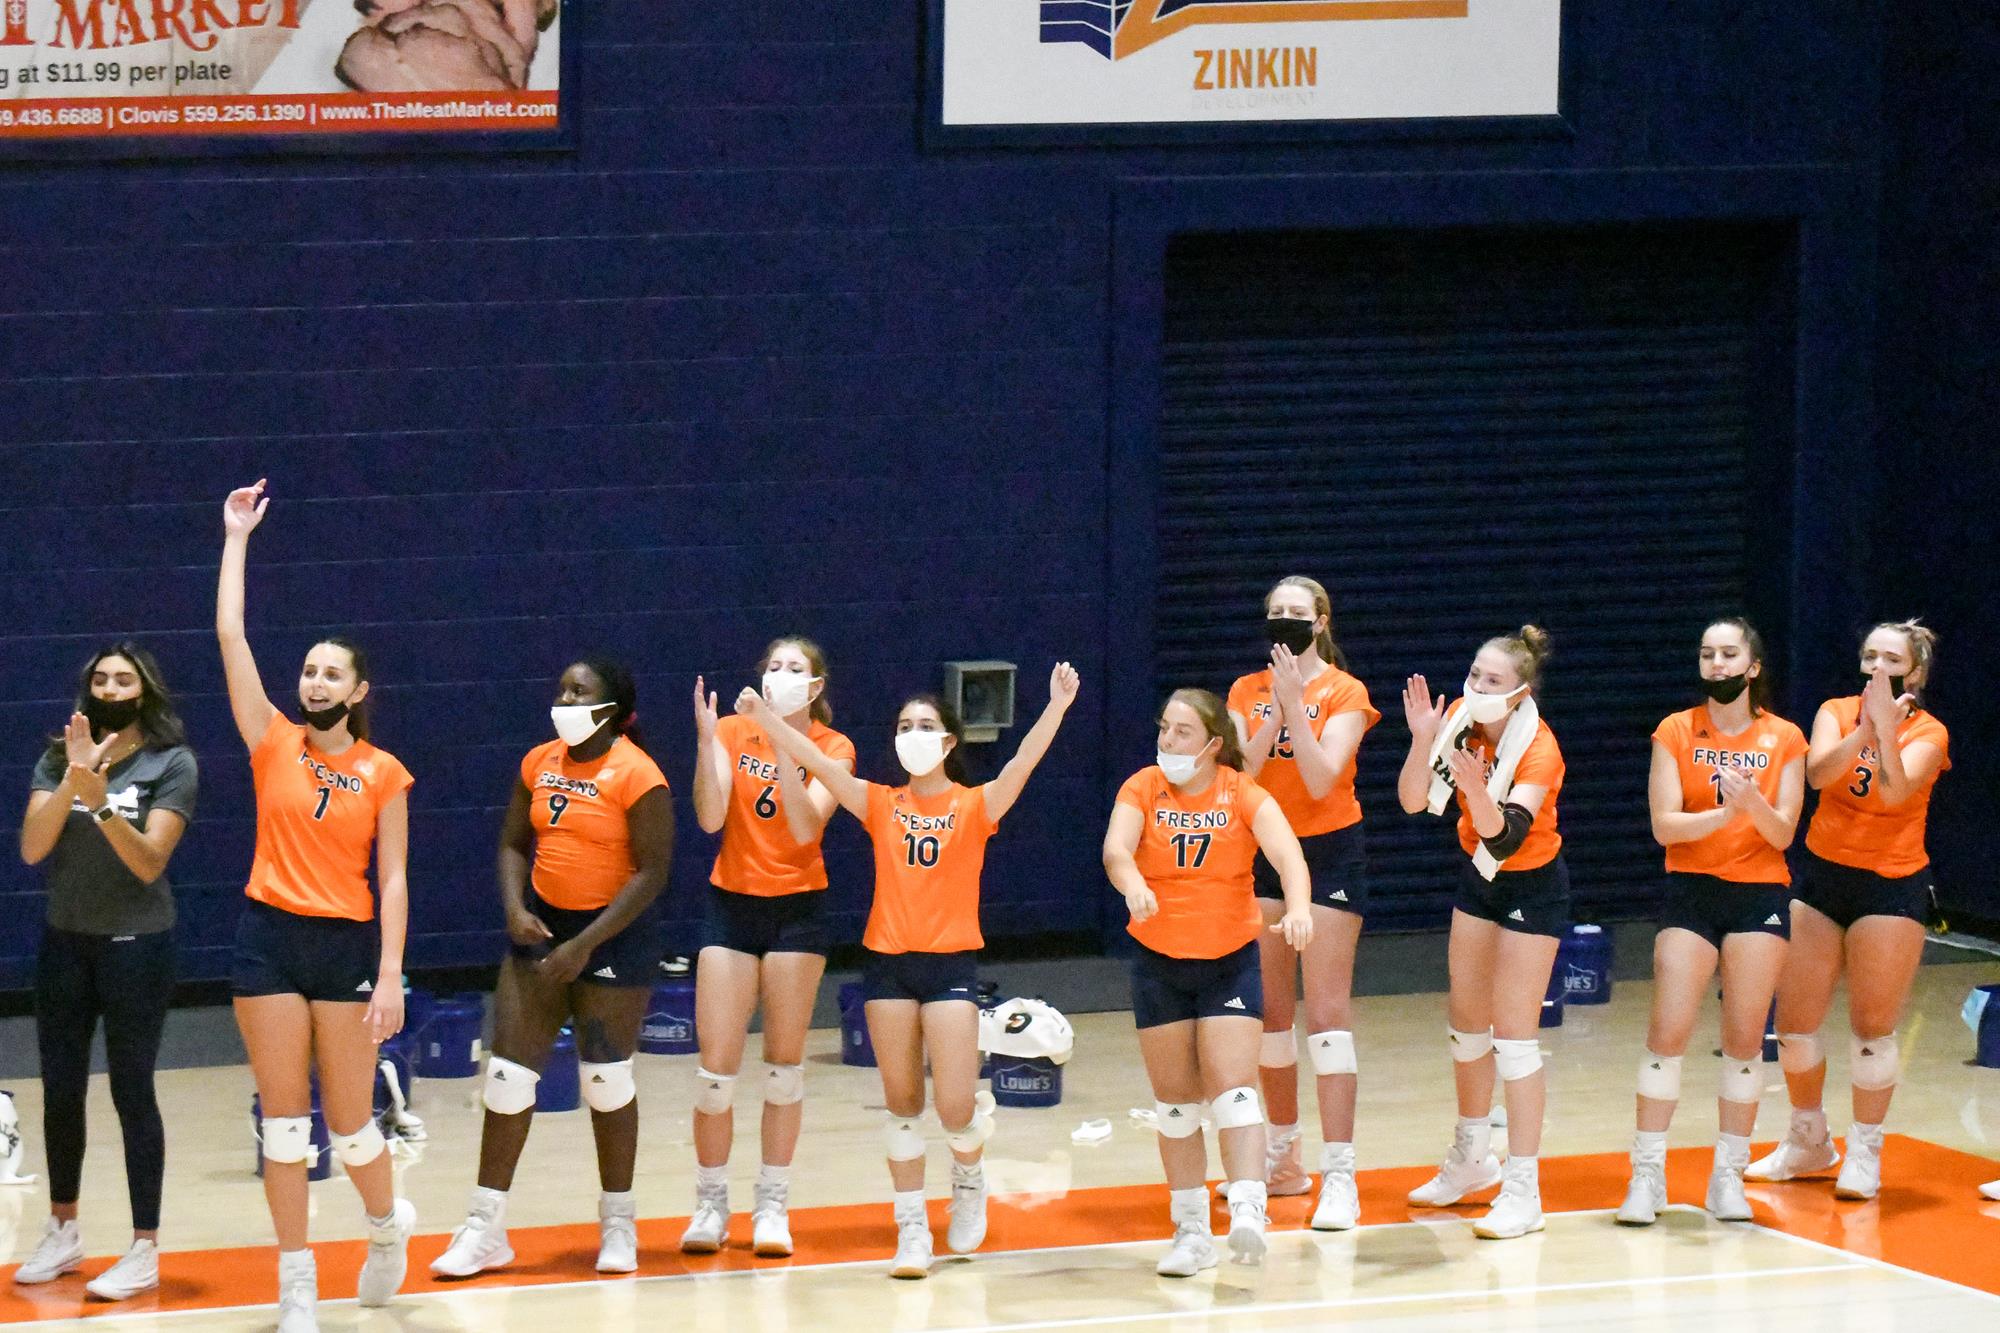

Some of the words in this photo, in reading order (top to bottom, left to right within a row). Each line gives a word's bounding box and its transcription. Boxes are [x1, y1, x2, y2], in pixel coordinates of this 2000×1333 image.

[18, 67, 39, 83] at
[47, 63, 121, 82] $11.99
[129, 65, 167, 86] per
[175, 60, 232, 84] plate
[1193, 47, 1317, 90] ZINKIN
[0, 107, 103, 126] 9.436.6688
[119, 106, 178, 124] Clovis
[184, 103, 305, 122] 559.256.1390
[320, 102, 558, 119] www.TheMeatMarket.com
[738, 753, 808, 783] FRESO
[1693, 748, 1769, 770] FRESNO
[1848, 765, 1873, 799] 3
[314, 786, 331, 821] 1
[548, 792, 570, 827] 9
[754, 784, 778, 820] 6
[1155, 809, 1229, 830] FRESNO
[903, 831, 940, 869] 10
[1170, 832, 1213, 868] 17
[1000, 1072, 1052, 1091] LOWE'S
